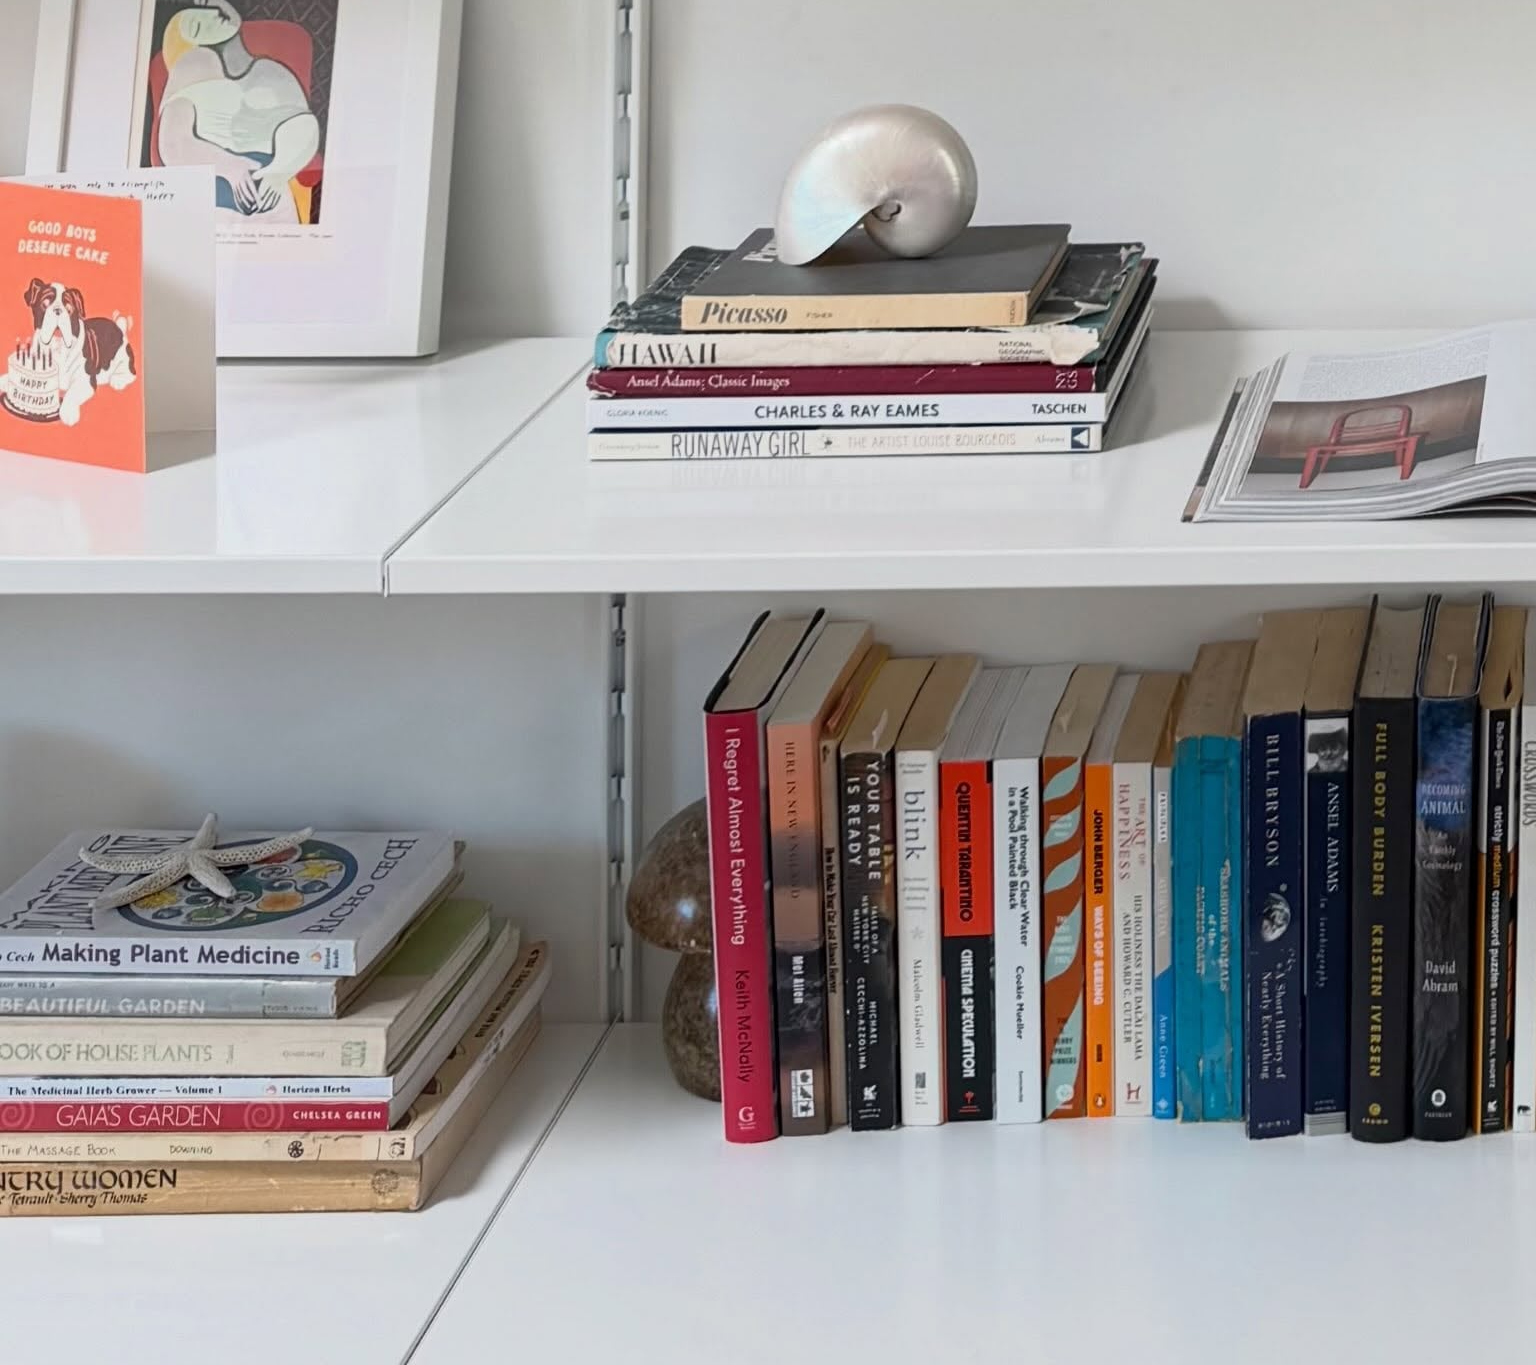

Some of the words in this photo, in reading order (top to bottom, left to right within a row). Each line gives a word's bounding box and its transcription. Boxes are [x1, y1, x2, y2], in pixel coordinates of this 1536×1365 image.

[28, 220, 61, 235] GOOD
[66, 224, 96, 241] BOYS
[18, 240, 70, 258] DESERVE
[76, 247, 109, 264] CAKE
[699, 302, 788, 325] Picasso
[13, 390, 54, 405] BIRTHDAY
[20, 377, 48, 389] HAPPY
[627, 375, 657, 389] Ansel
[708, 375, 746, 389] Classic
[750, 375, 789, 390] Images
[755, 405, 828, 420] CHARLES
[832, 405, 843, 419] &
[850, 405, 880, 418] RAY
[885, 404, 939, 418] EAMES
[1032, 403, 1086, 414] TASCHEN
[670, 434, 761, 458] RUNAWAY
[768, 432, 811, 456] GIRL
[1265, 735, 1279, 780] BILL
[1374, 723, 1386, 762] FULL
[723, 739, 740, 791] Regret
[1008, 787, 1017, 796] in
[1018, 787, 1029, 831] Walking
[1374, 772, 1386, 819] BODY
[729, 797, 744, 853] Almost
[904, 790, 925, 860] blink
[957, 782, 970, 843] QUENTIN
[1009, 810, 1018, 832] Pool
[1094, 810, 1104, 841] JOHN
[1265, 788, 1279, 868] BRYSON
[1008, 836, 1019, 877] Painted
[1017, 834, 1030, 877] through
[1094, 845, 1104, 894] BERGER
[1373, 827, 1385, 895] BURDEN
[728, 859, 747, 945] Everything
[959, 847, 972, 921] TARANTINO
[1009, 881, 1019, 909] Black
[1020, 881, 1030, 910] Clear
[1020, 914, 1030, 946] Water
[42, 943, 120, 965] Making
[131, 944, 193, 964] Plant
[198, 944, 300, 964] Medicine
[962, 949, 974, 994] CINEMA
[1371, 925, 1383, 996] KRISTEN
[736, 970, 752, 1010] Keith
[1015, 966, 1024, 998] Cookie
[962, 998, 975, 1077] SPECULATION
[1015, 1001, 1025, 1039] Mueller
[737, 1016, 755, 1083] McNally
[1369, 1005, 1381, 1076] IVERSEN
[56, 1105, 121, 1125] GAIA'S
[129, 1105, 220, 1126] GARDEN
[293, 1110, 340, 1119] CHELSEA
[346, 1110, 381, 1119] GREEN
